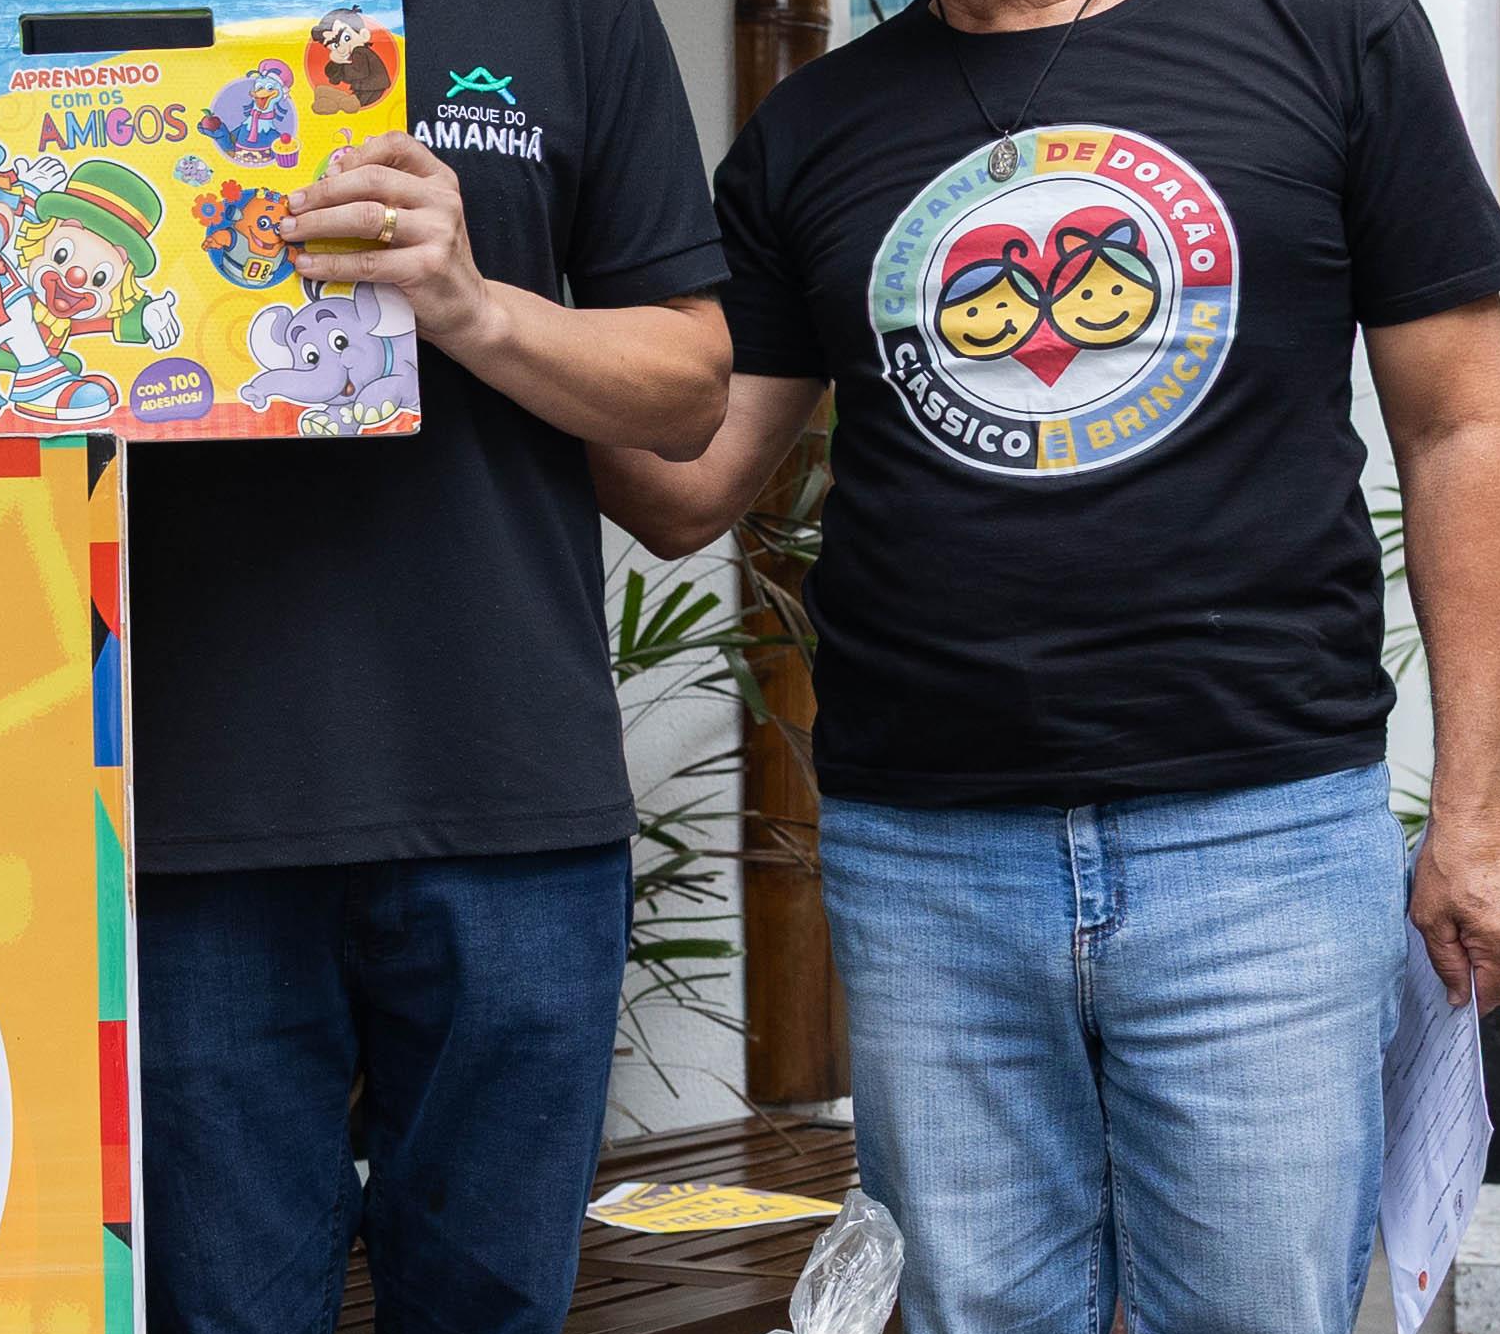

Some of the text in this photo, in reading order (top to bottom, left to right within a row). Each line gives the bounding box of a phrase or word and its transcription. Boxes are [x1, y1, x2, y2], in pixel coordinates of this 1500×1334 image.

[10, 66, 159, 90] APRENDENDO
[51, 90, 123, 108] com os
[39, 104, 187, 151] AMIGOS
[437, 105, 526, 126] CRAQUE DO
[414, 120, 543, 162] AMANHÃ
[1046, 143, 1097, 162] DE
[1107, 148, 1216, 272] DOAÇÃO
[136, 372, 200, 397] COM 100
[1088, 302, 1220, 451] BRINCAR
[140, 391, 203, 411] ADESIVOS!
